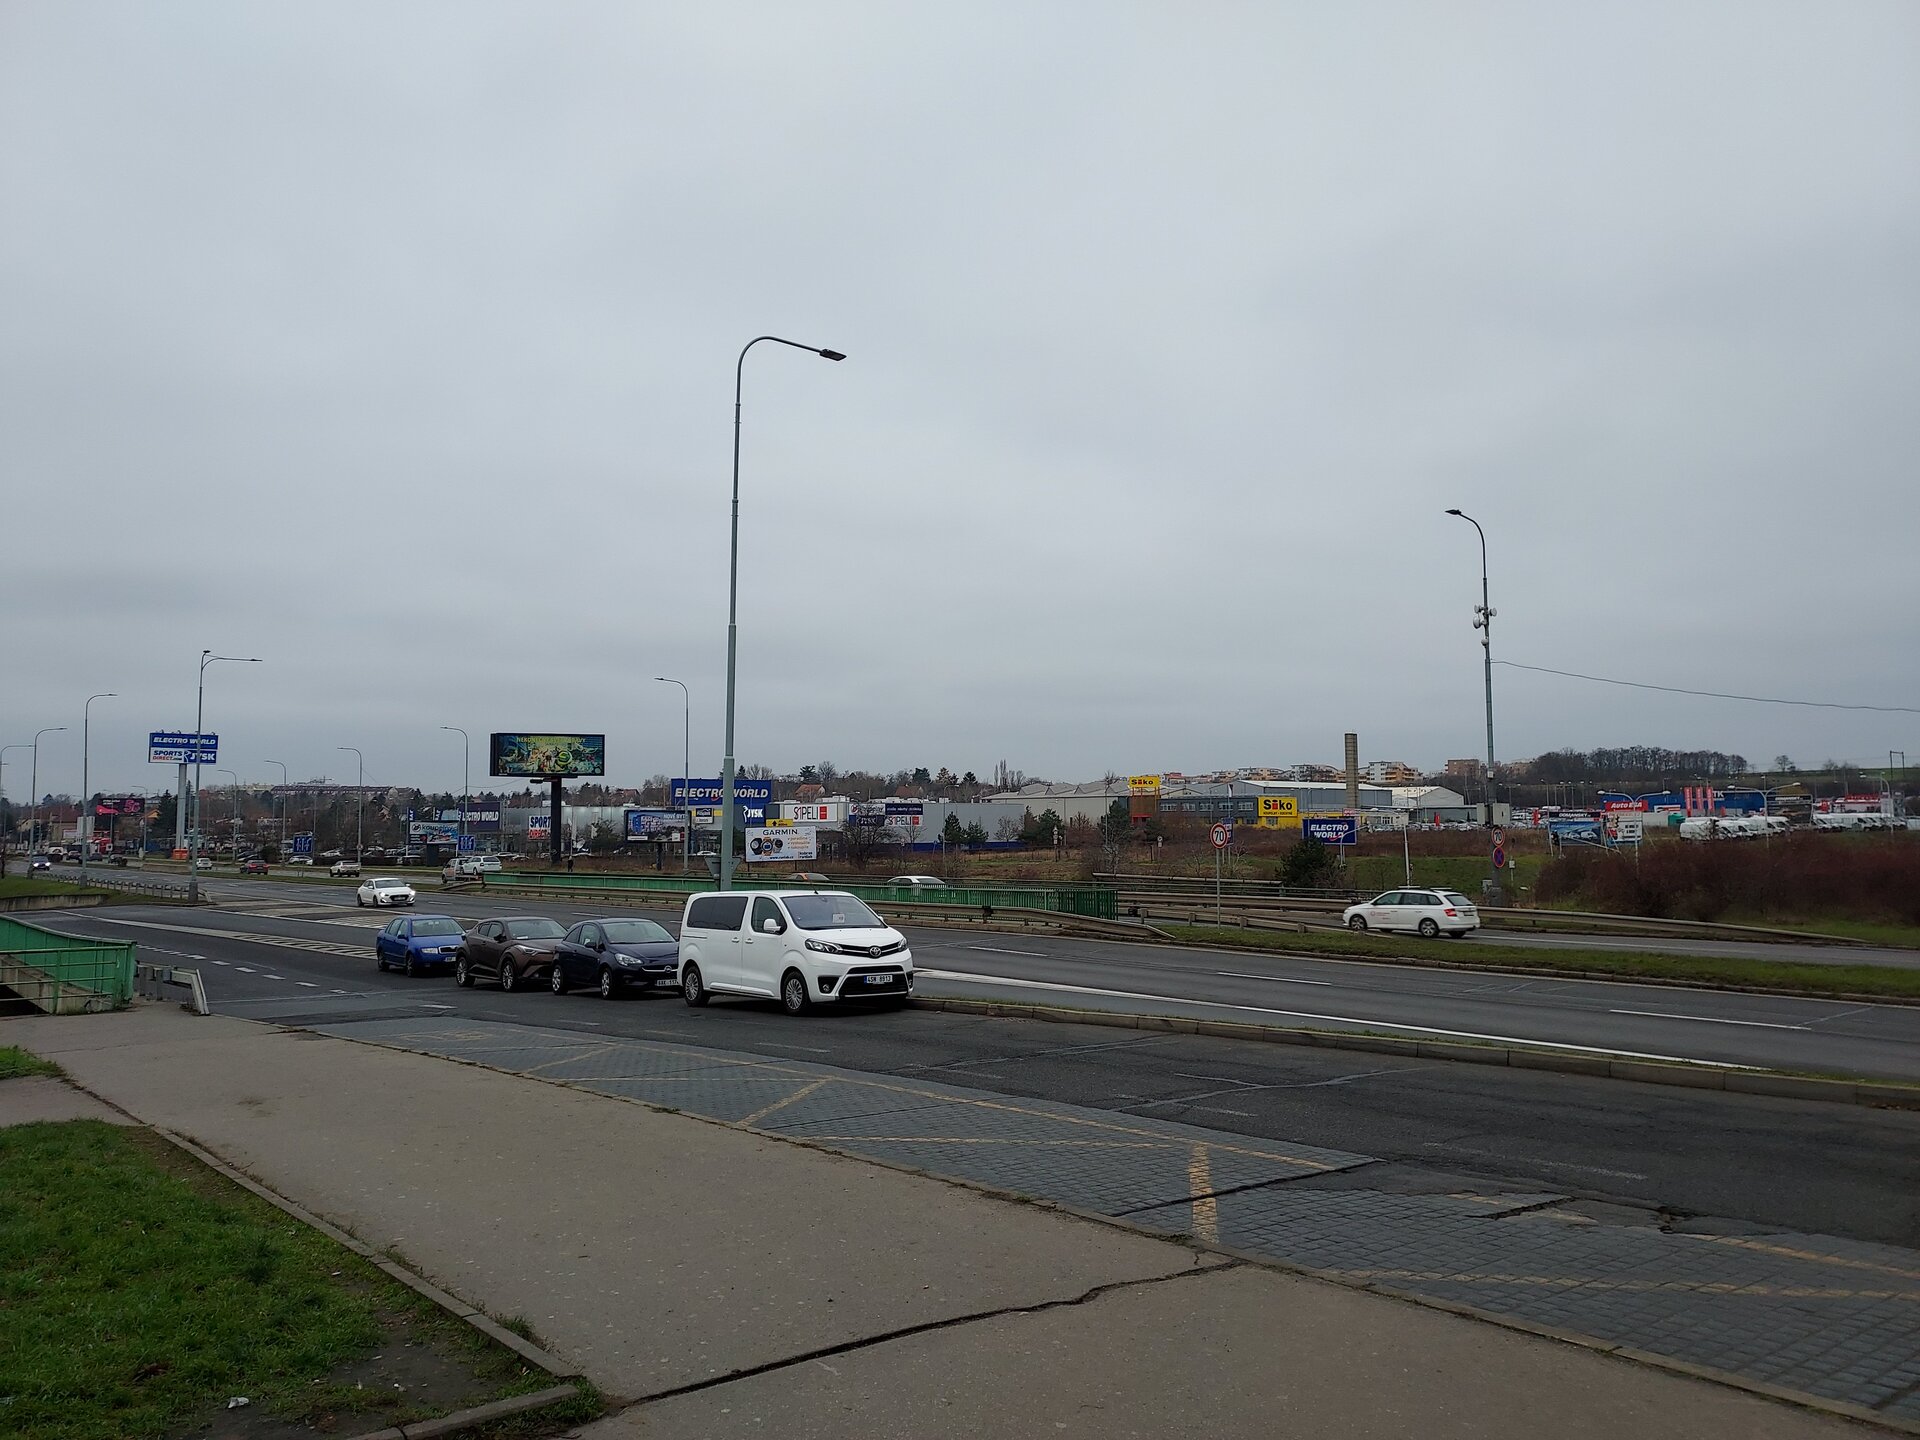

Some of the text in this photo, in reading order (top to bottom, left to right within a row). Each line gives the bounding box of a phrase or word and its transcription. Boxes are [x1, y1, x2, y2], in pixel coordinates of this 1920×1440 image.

[1263, 799, 1292, 811] Siko
[482, 811, 499, 821] WORLD
[747, 808, 763, 818] JYSK
[1214, 830, 1224, 842] 70
